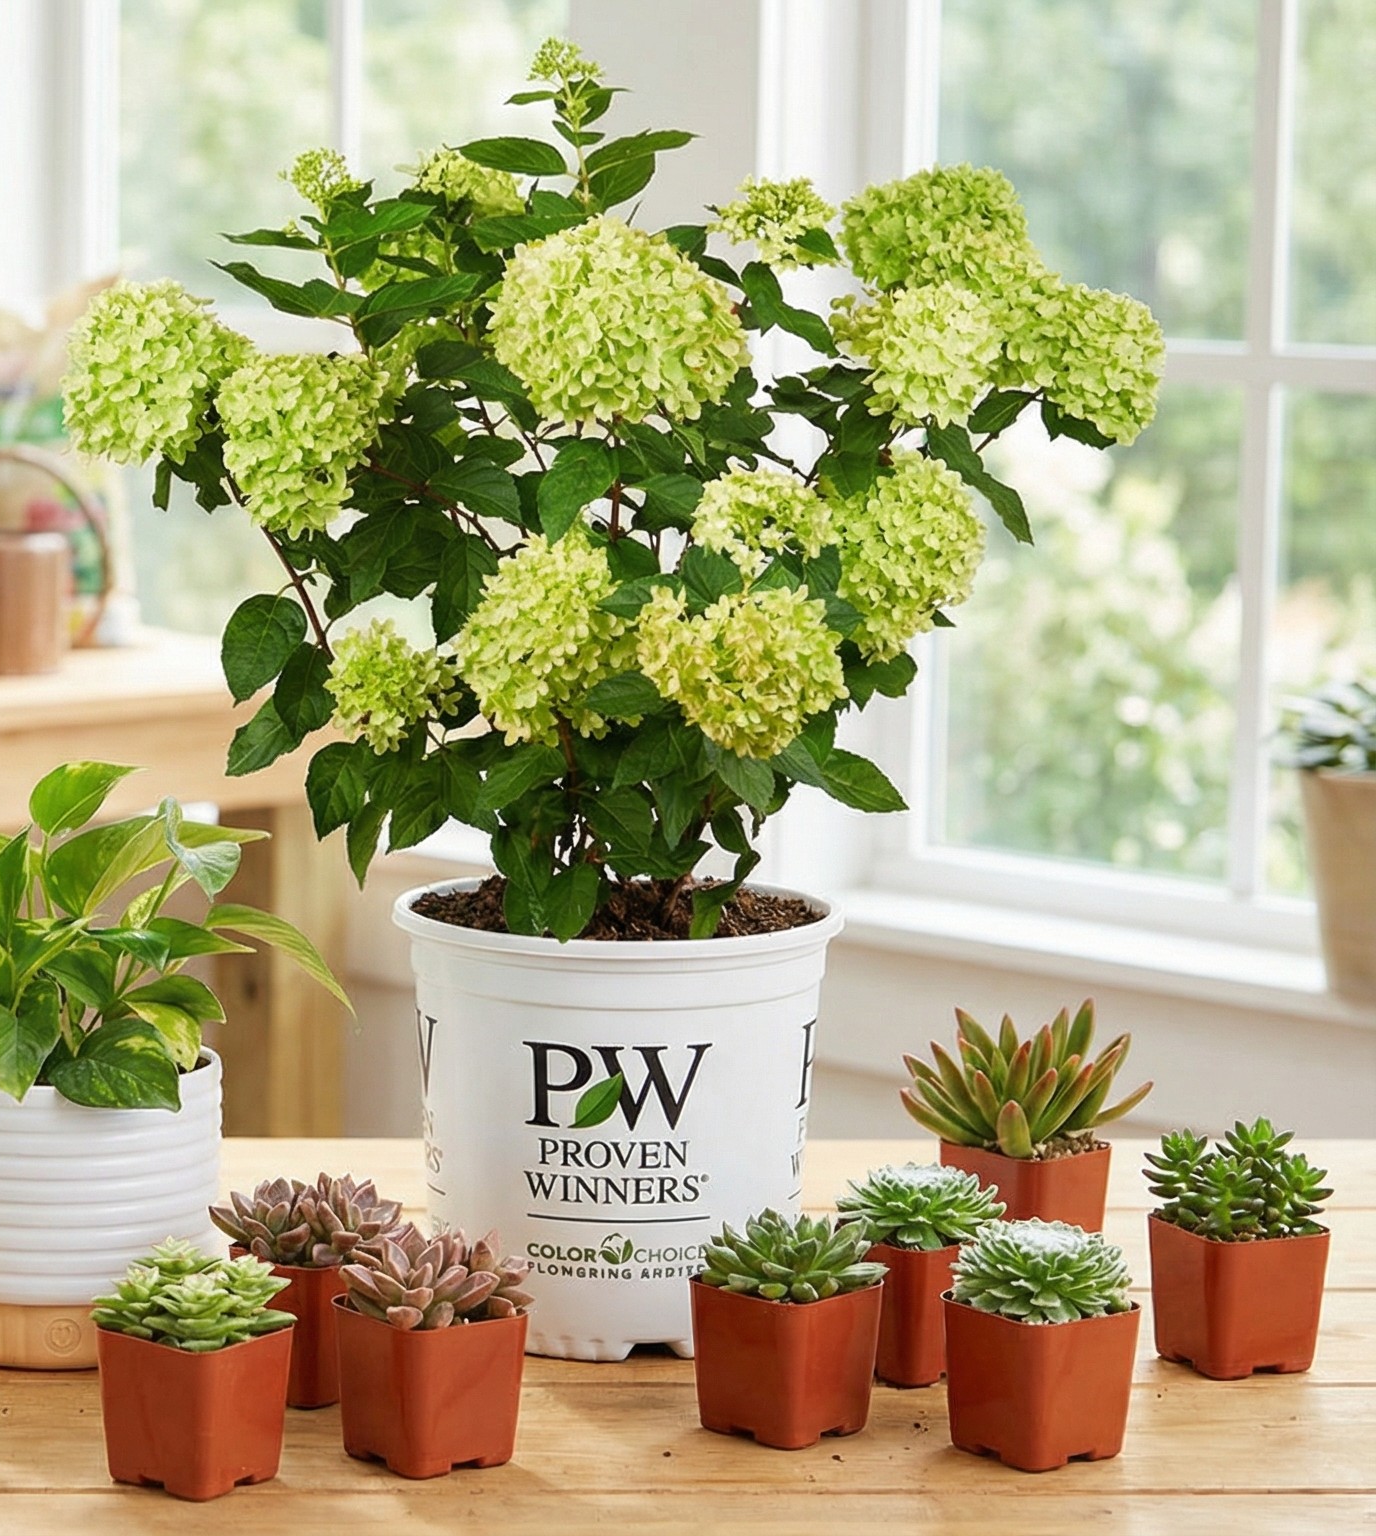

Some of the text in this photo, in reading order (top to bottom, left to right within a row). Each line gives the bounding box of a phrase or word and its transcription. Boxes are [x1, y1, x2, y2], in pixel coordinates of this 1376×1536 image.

[523, 1041, 713, 1131] PW
[538, 1138, 690, 1169] PROVEN
[526, 1243, 597, 1263] COLOR
